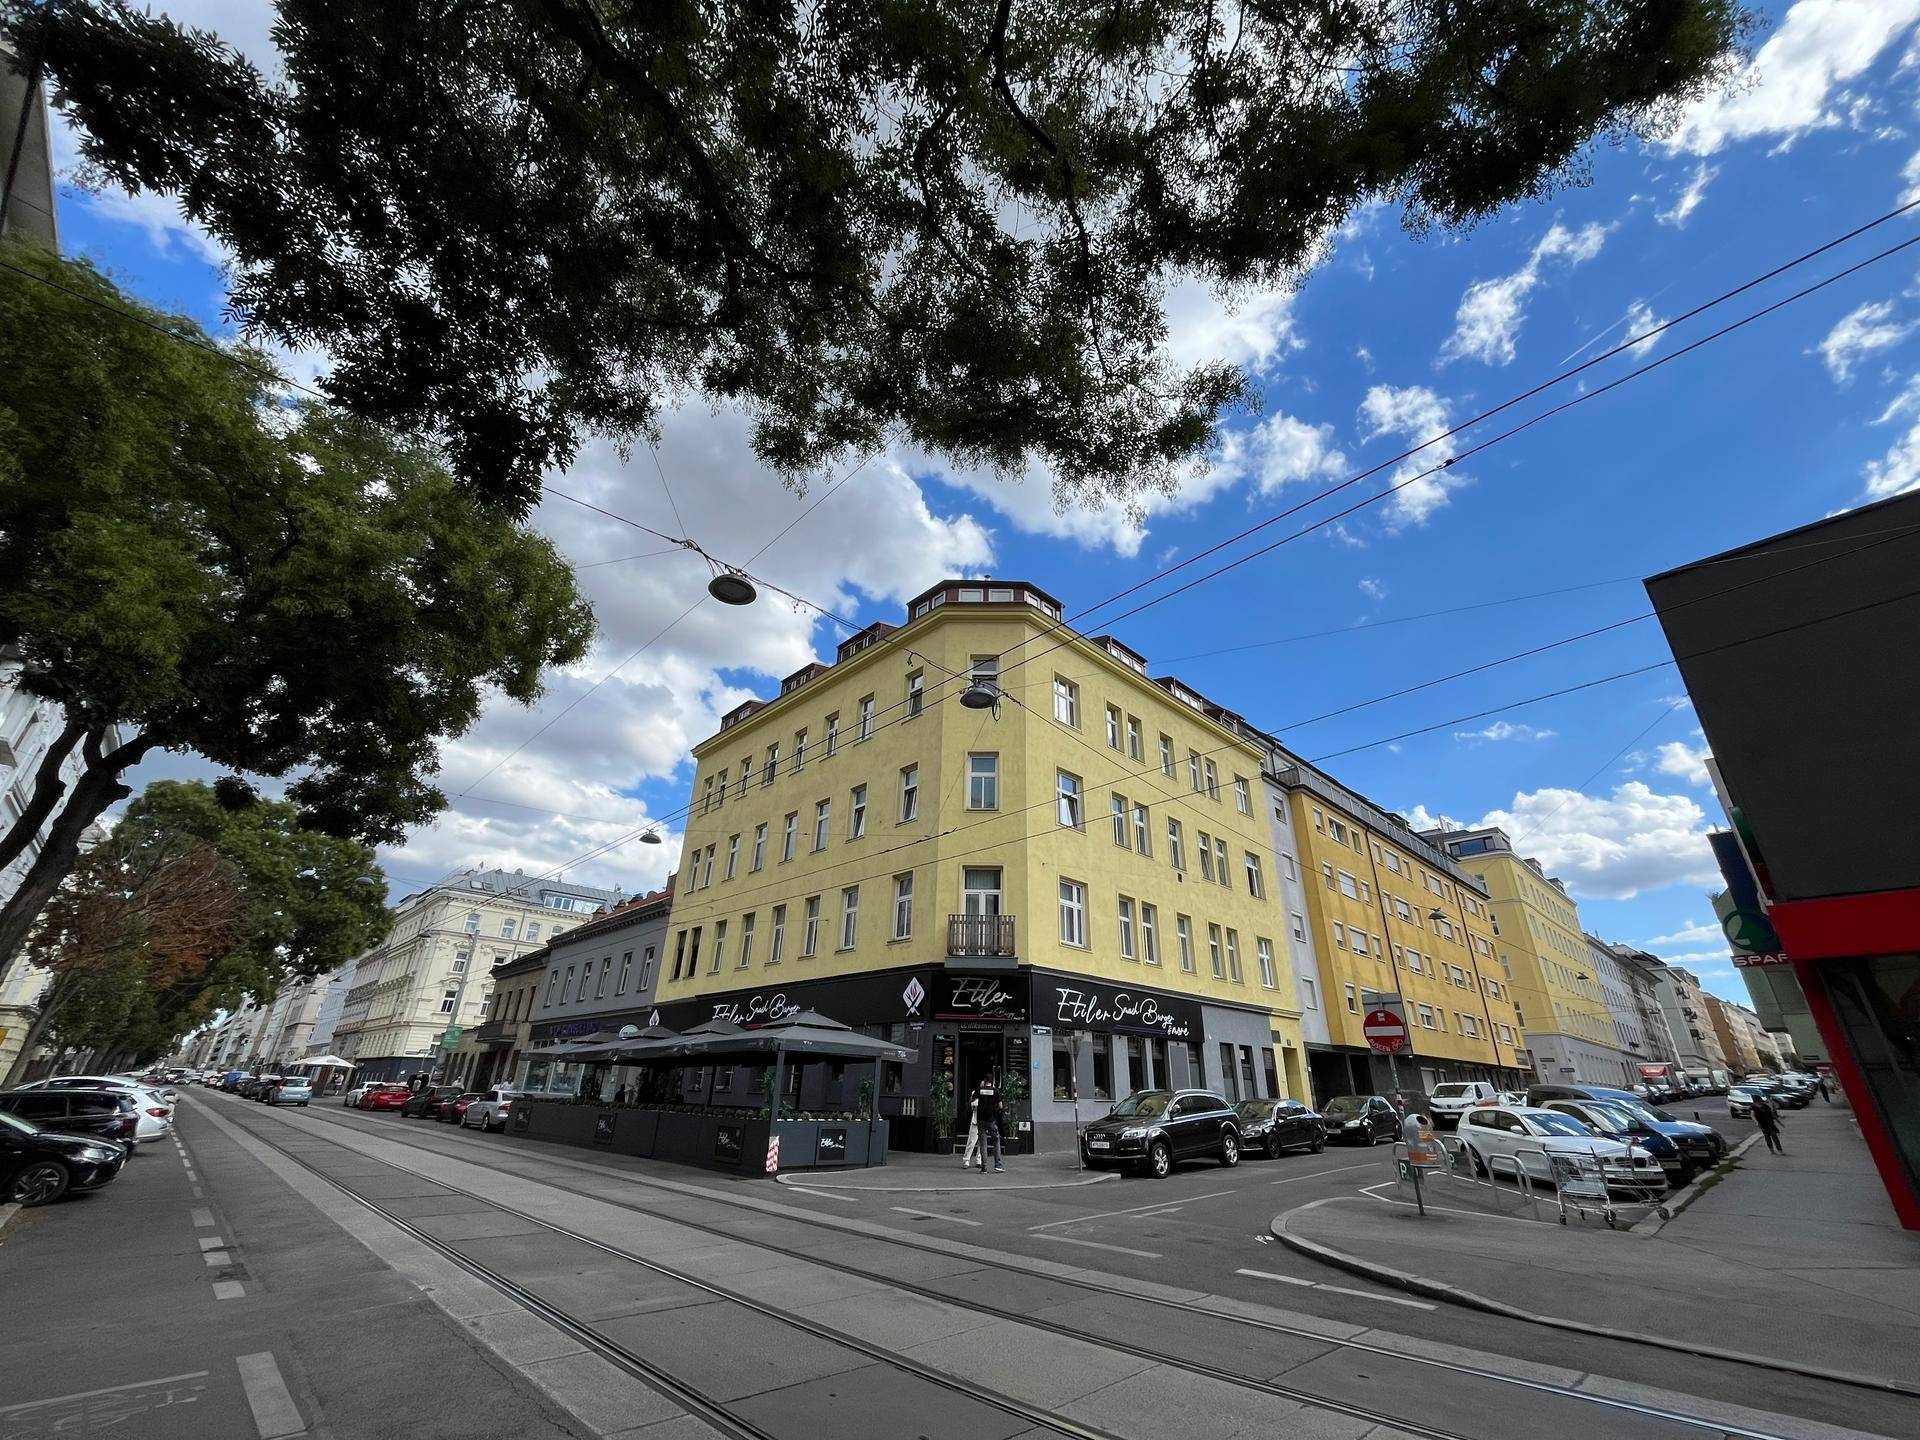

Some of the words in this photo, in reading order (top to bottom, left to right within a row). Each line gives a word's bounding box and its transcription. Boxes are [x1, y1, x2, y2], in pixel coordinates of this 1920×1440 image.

[769, 993, 801, 1019] Burger
[950, 977, 1012, 1007] Etiler
[1056, 988, 1111, 1024] Etiler
[1113, 994, 1141, 1021] Snack
[1140, 998, 1175, 1029] Burger
